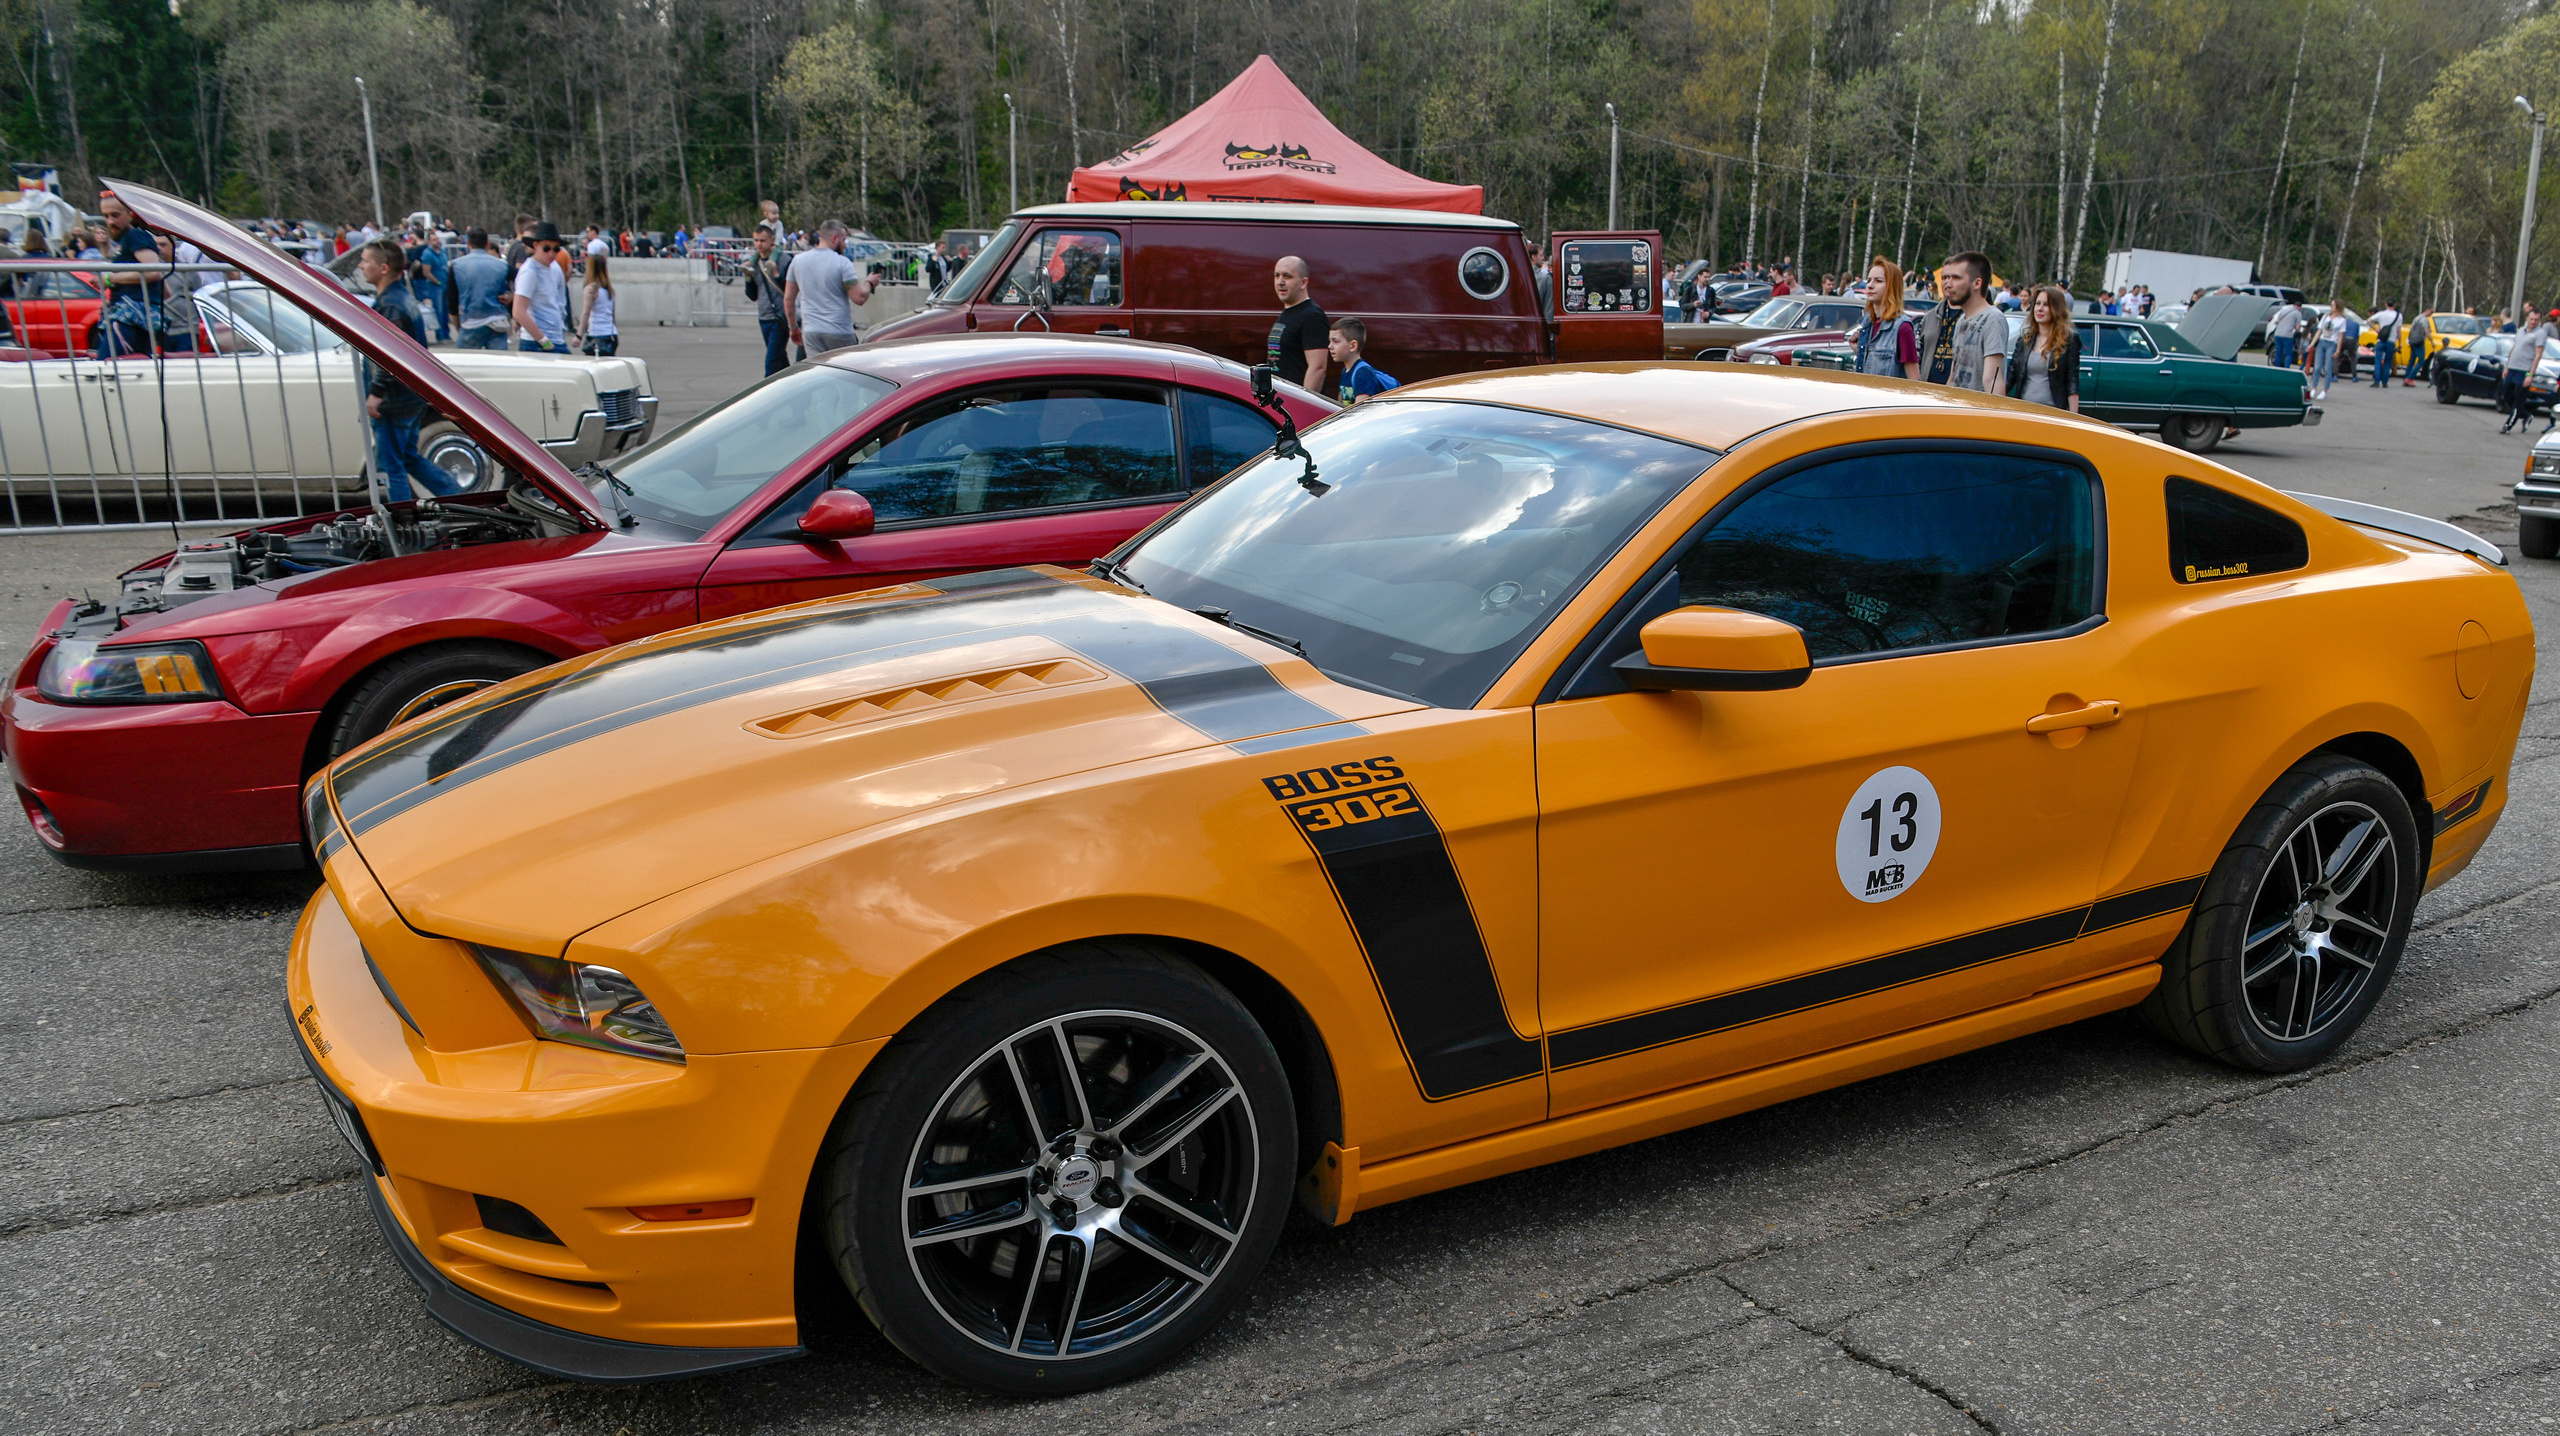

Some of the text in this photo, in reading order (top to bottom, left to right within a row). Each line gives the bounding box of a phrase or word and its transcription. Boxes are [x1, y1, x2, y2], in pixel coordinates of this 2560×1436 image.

[1846, 591, 1889, 615] BOSS
[1847, 605, 1880, 625] 302
[1261, 756, 1404, 801] BOSS
[1297, 788, 1420, 832] 302
[1861, 792, 1918, 857] 13
[1880, 883, 1904, 893] BUCKETS
[1062, 1177, 1094, 1188] RACING
